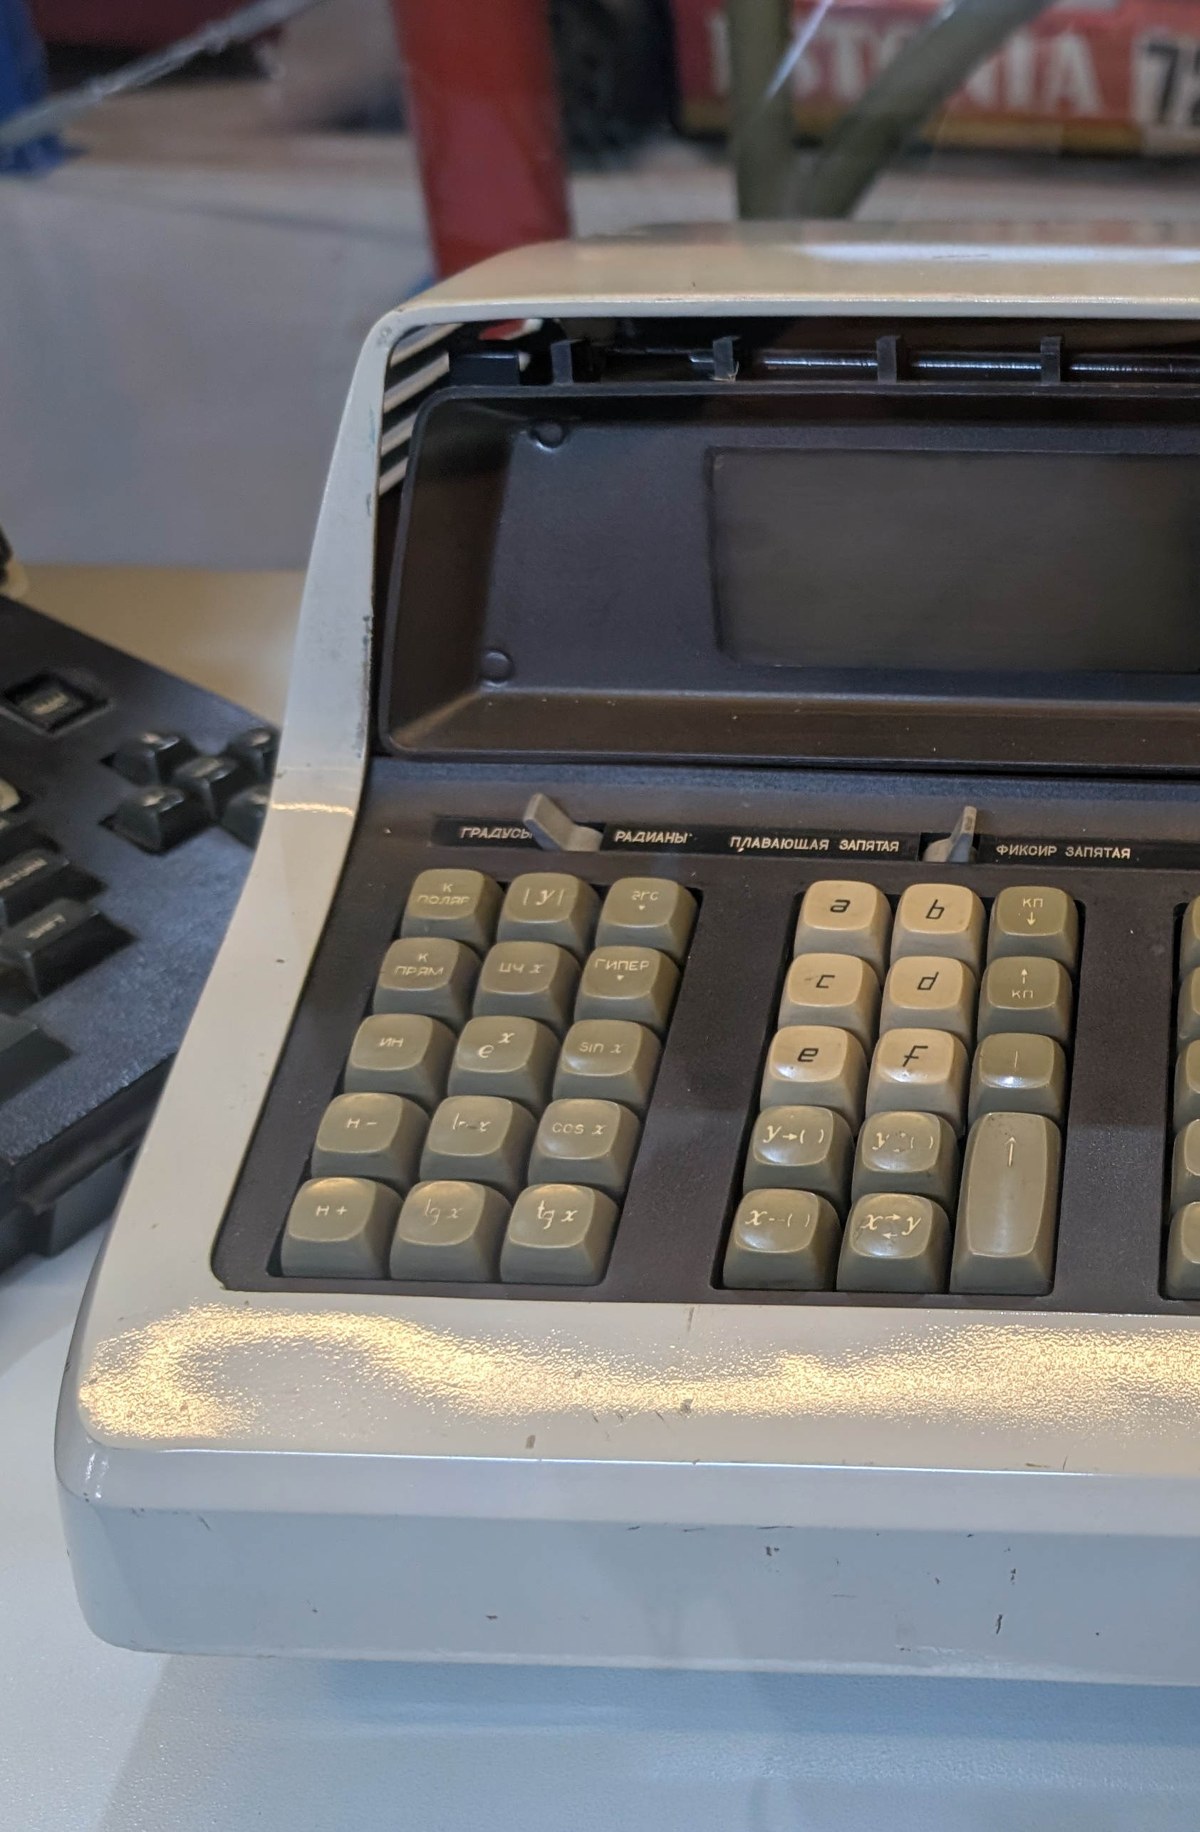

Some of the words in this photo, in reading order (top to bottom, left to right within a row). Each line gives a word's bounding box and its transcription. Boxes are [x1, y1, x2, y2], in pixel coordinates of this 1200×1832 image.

[708, 14, 1103, 116] STNIA
[614, 830, 688, 844] РАДИАНЫ
[730, 836, 830, 852] ПЛАВАЮЩАЯ
[838, 839, 900, 853] ЗАПЯТАЯ
[995, 843, 1058, 858] ФИКСИР
[1065, 844, 1131, 859] ЗАПЯТАЯ
[830, 899, 851, 913] a
[926, 899, 945, 920] b
[1022, 898, 1044, 908] КП
[394, 965, 444, 977] ПРЯМ
[594, 958, 650, 971] ГИПЕР
[816, 974, 836, 989] c
[917, 971, 940, 991] d
[1011, 989, 1034, 999] КП
[579, 1041, 604, 1053] sin
[797, 1047, 819, 1063] e
[551, 1122, 585, 1135] cos
[537, 1200, 555, 1230] tg
